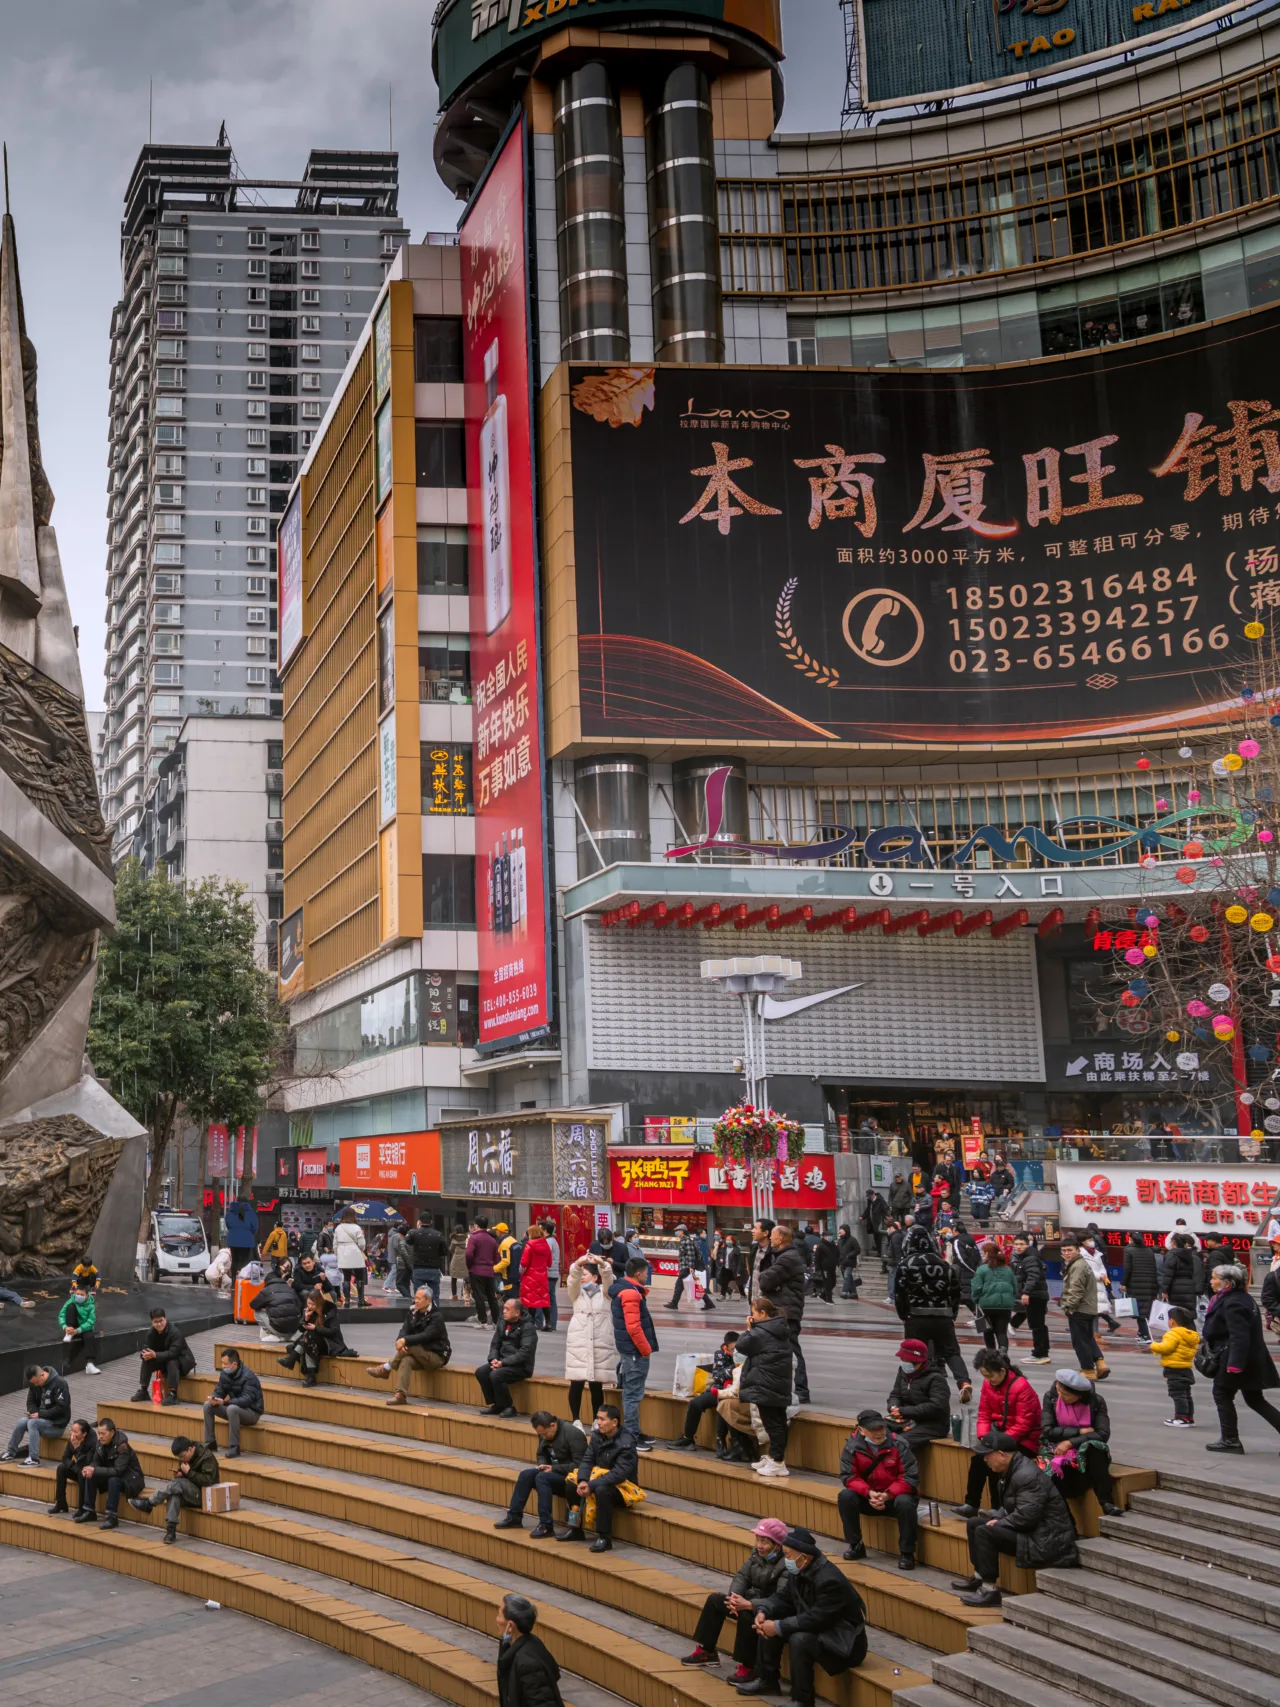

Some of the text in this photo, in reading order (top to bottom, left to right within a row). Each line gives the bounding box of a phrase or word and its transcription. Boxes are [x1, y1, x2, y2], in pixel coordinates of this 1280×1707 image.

[1008, 28, 1076, 58] TAO
[679, 419, 791, 431] 拉摩国际新青年购物中心
[679, 400, 1280, 540] 本商厦旺铺
[945, 563, 1197, 611] 18502316484
[948, 595, 1200, 642] 15023394257
[949, 624, 1229, 673] 023-65466166
[476, 638, 528, 714] 祝全国人民
[477, 682, 529, 761] 新年快乐
[478, 735, 533, 809] 万事如意
[909, 873, 1065, 898] 一号入口
[1093, 1052, 1200, 1071] 商场入
[378, 1141, 406, 1165] 平安银行
[467, 1127, 514, 1176] 周六福
[568, 1124, 589, 1198] 周六福
[617, 1157, 689, 1190] 张鸭子
[634, 1180, 659, 1188] ZHANG
[1136, 1178, 1279, 1206] 凯瑞商都生
